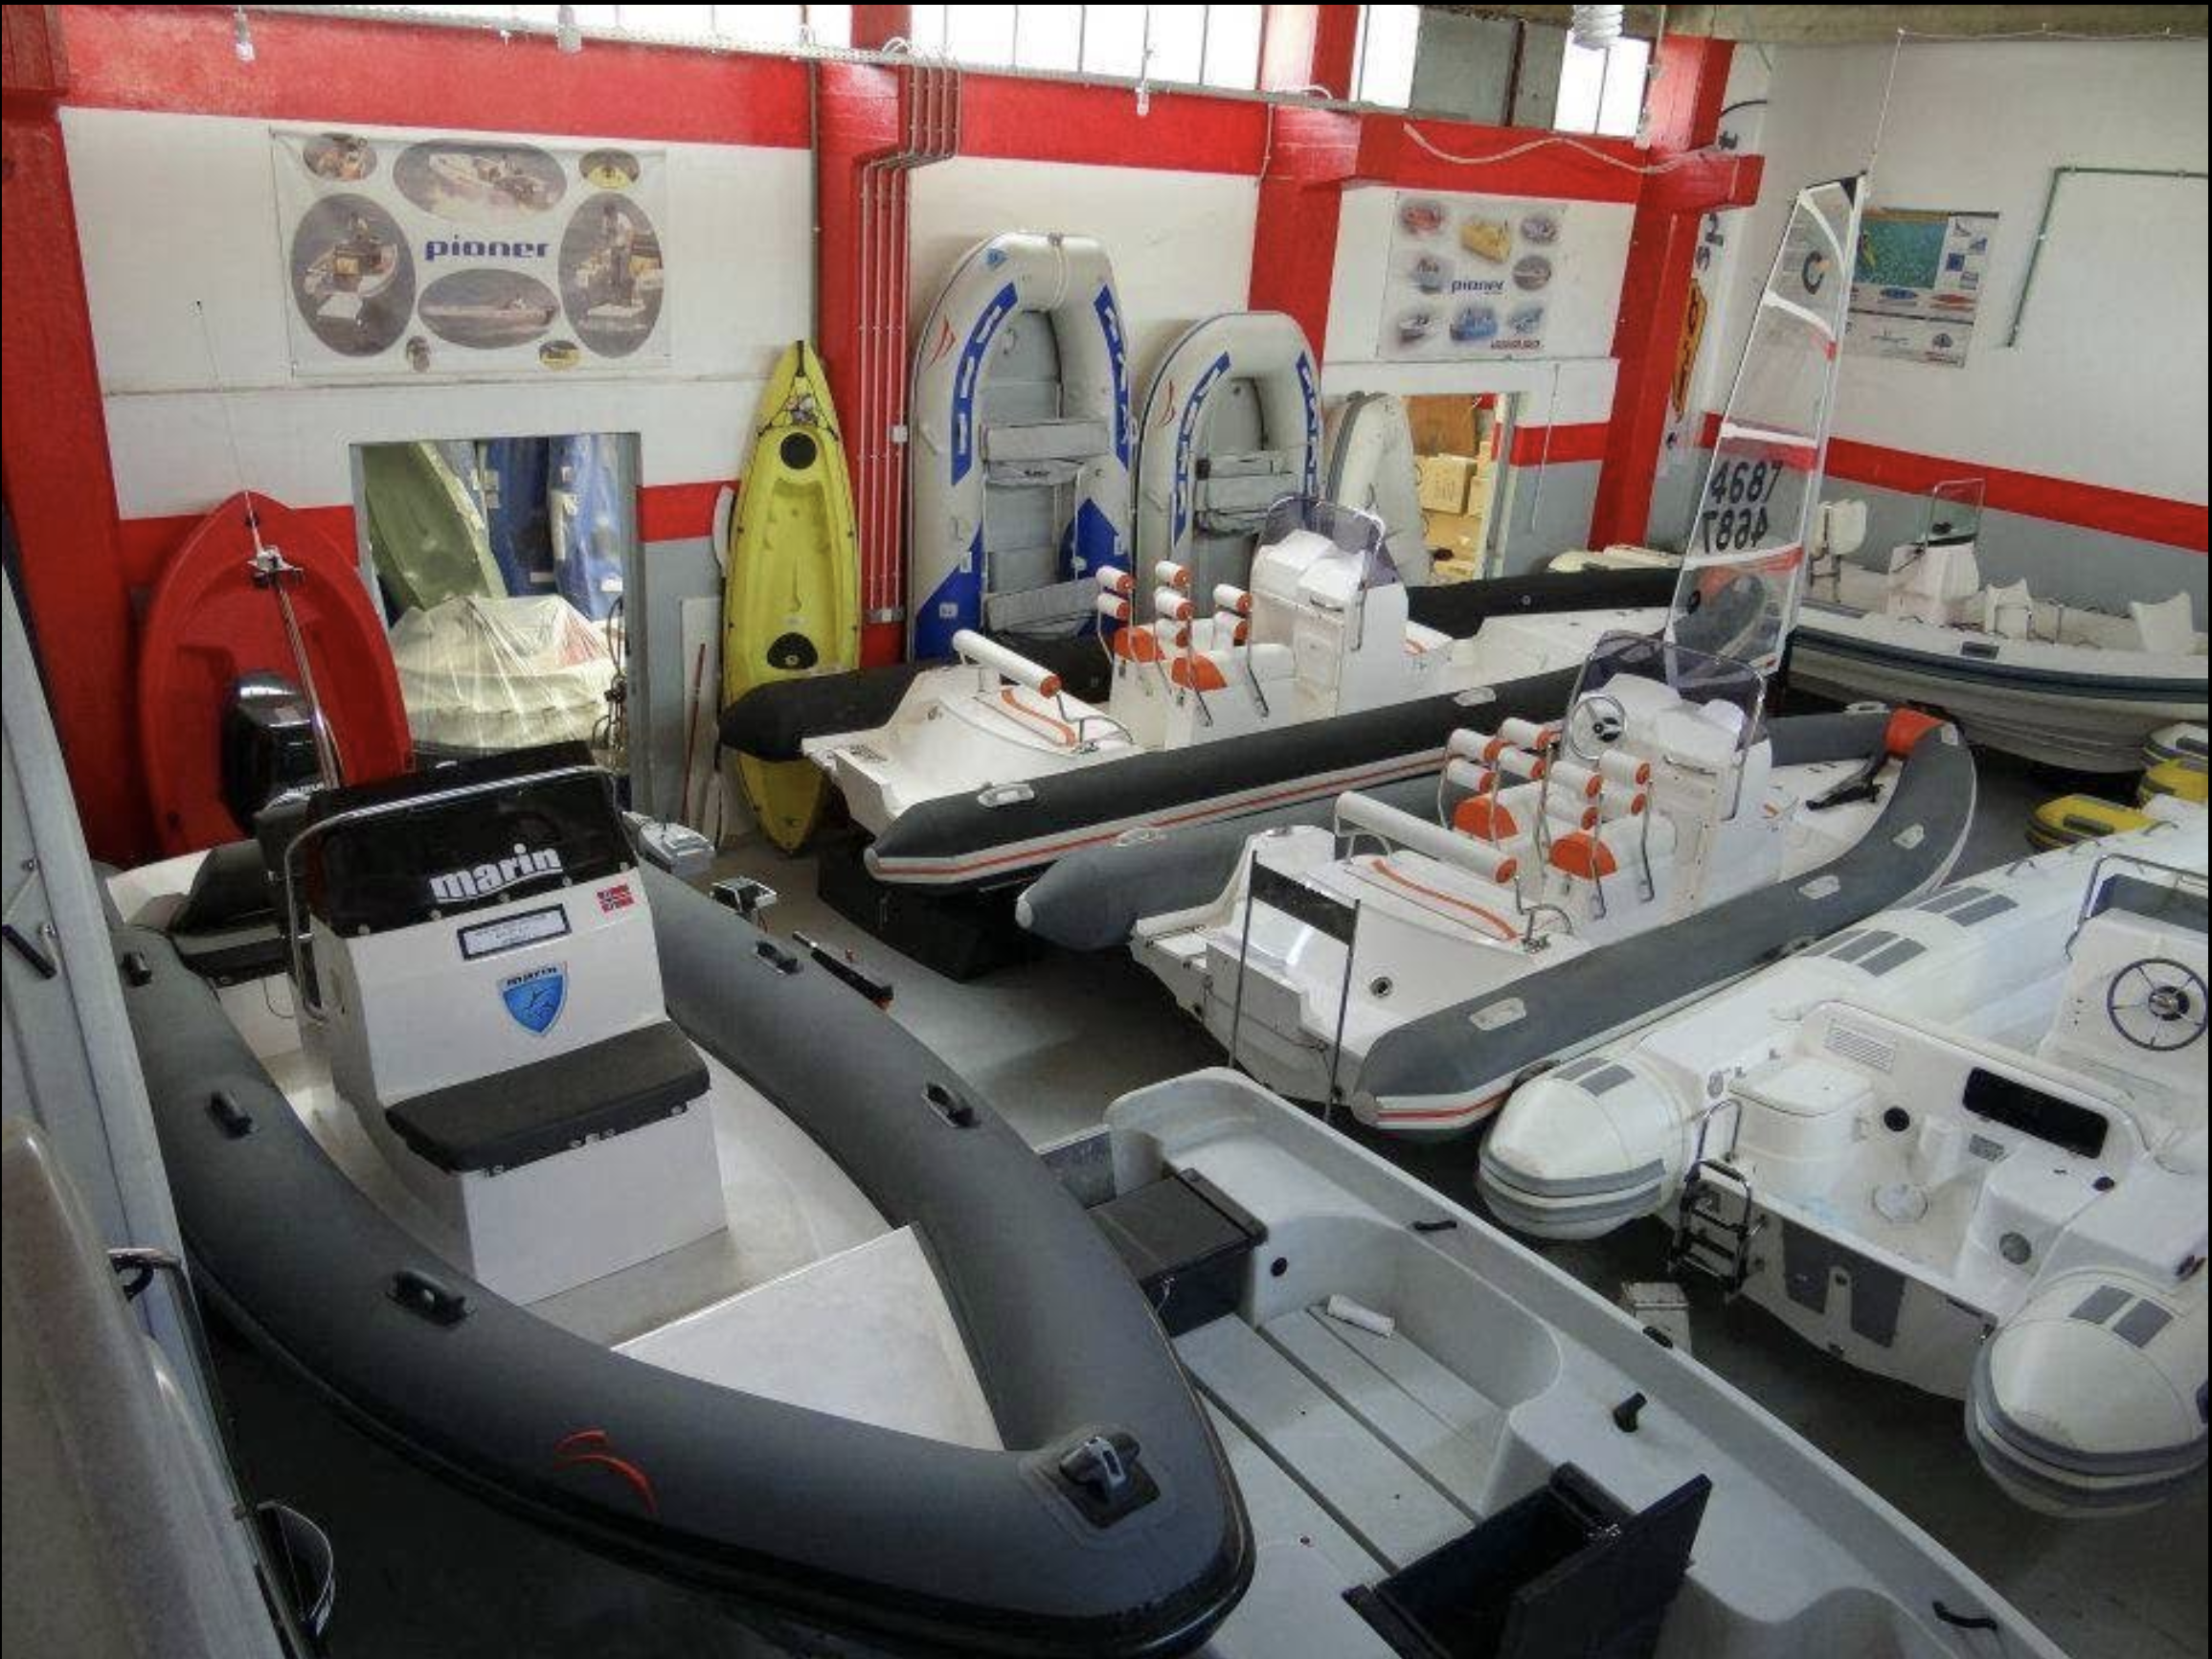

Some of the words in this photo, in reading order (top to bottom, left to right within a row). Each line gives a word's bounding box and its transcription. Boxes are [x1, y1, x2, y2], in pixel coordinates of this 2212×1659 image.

[424, 234, 551, 261] pioner
[1710, 460, 1784, 505] 4687
[429, 843, 563, 901] marin
